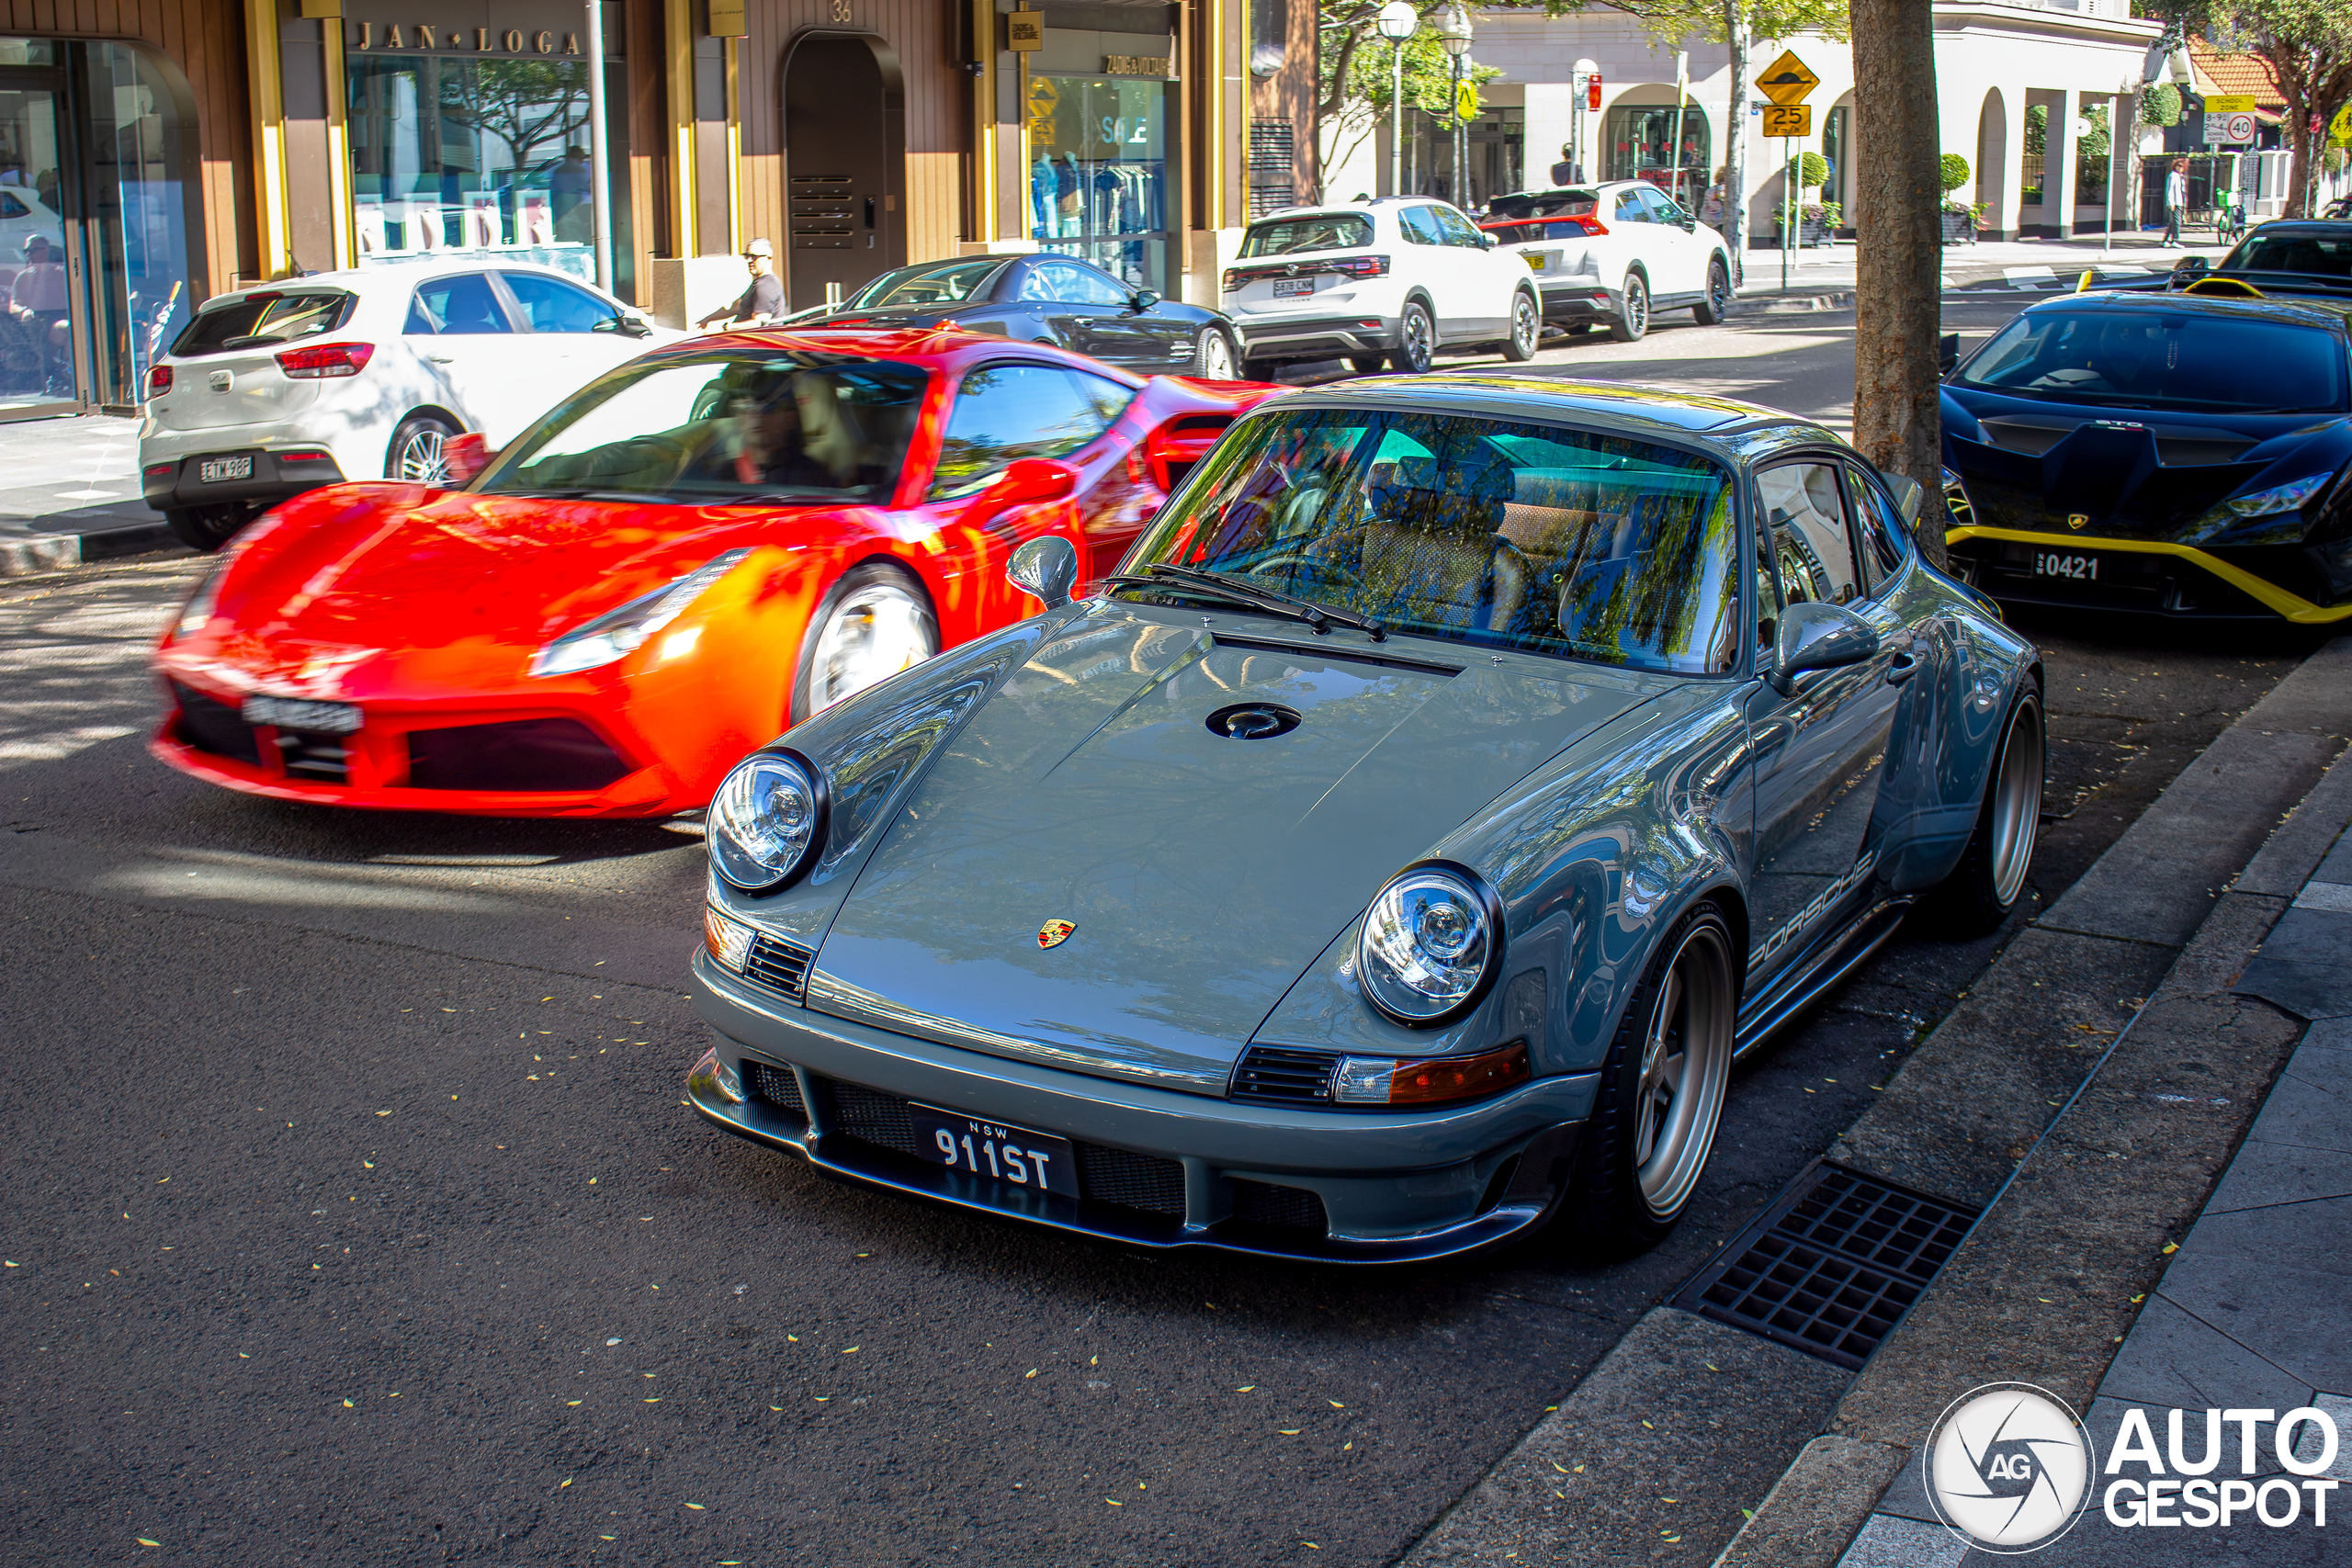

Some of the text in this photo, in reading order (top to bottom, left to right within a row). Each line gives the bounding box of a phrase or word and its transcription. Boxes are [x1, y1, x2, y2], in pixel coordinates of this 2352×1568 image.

[832, 0, 852, 22] 36
[359, 22, 608, 56] JAN LOGA
[1773, 107, 1802, 124] 25
[2233, 122, 2250, 133] 40
[1102, 117, 1147, 144] SALE
[2096, 420, 2143, 428] STO
[2046, 553, 2098, 581] 0421
[1747, 850, 1873, 969] PORSCHE
[969, 1121, 1007, 1140] NSW
[935, 1128, 1050, 1190] 911ST
